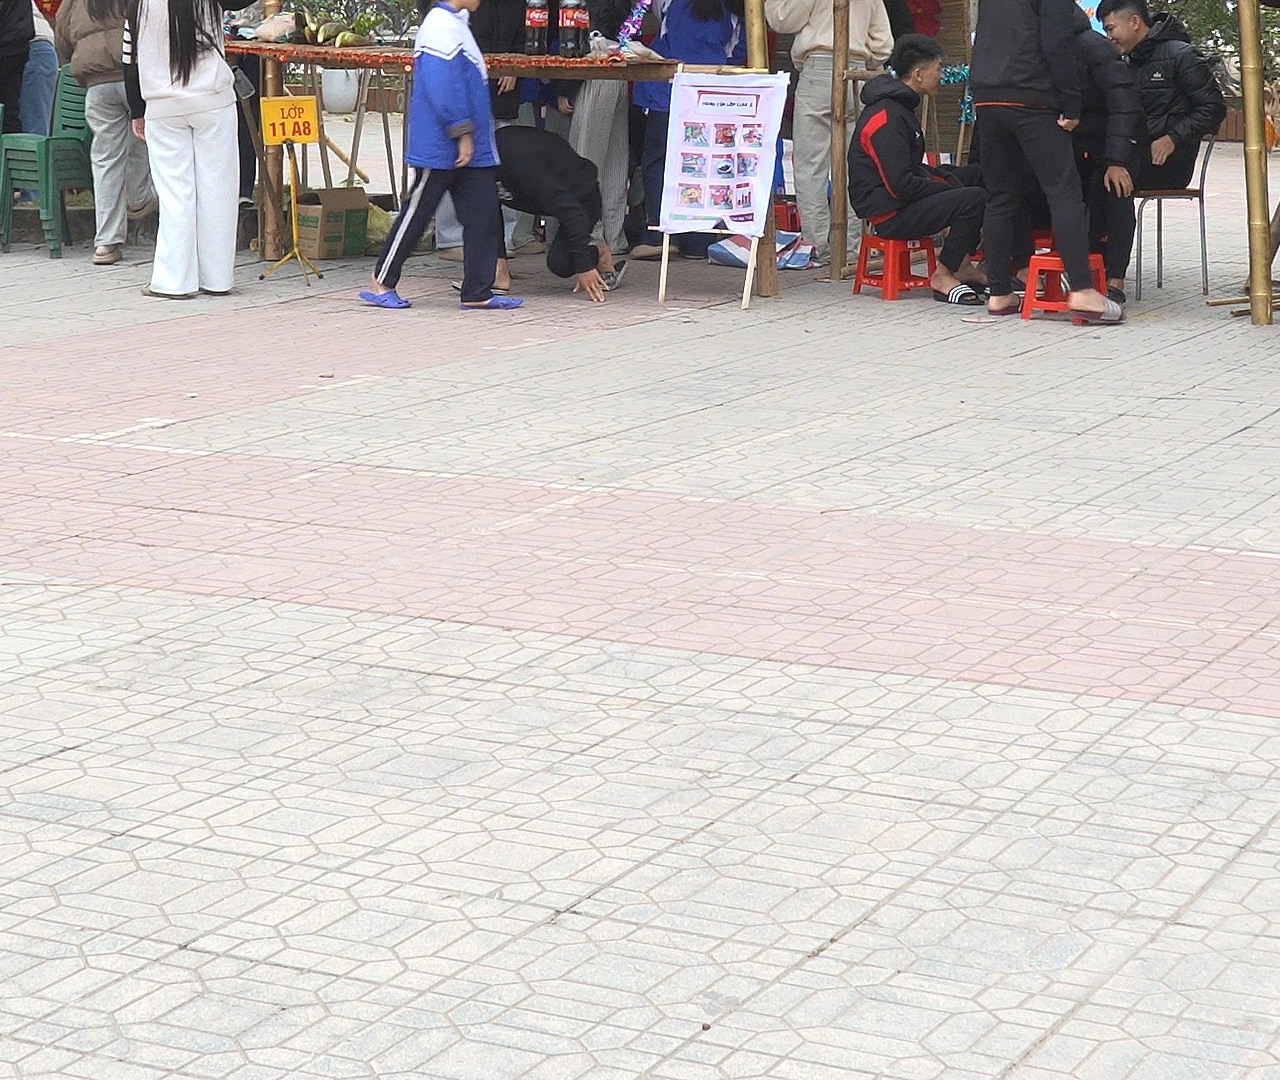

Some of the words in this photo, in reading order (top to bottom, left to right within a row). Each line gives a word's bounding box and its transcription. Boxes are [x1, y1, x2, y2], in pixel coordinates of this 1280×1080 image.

[281, 104, 304, 119] LỚP
[269, 122, 286, 137] 11
[291, 121, 312, 137] A8
